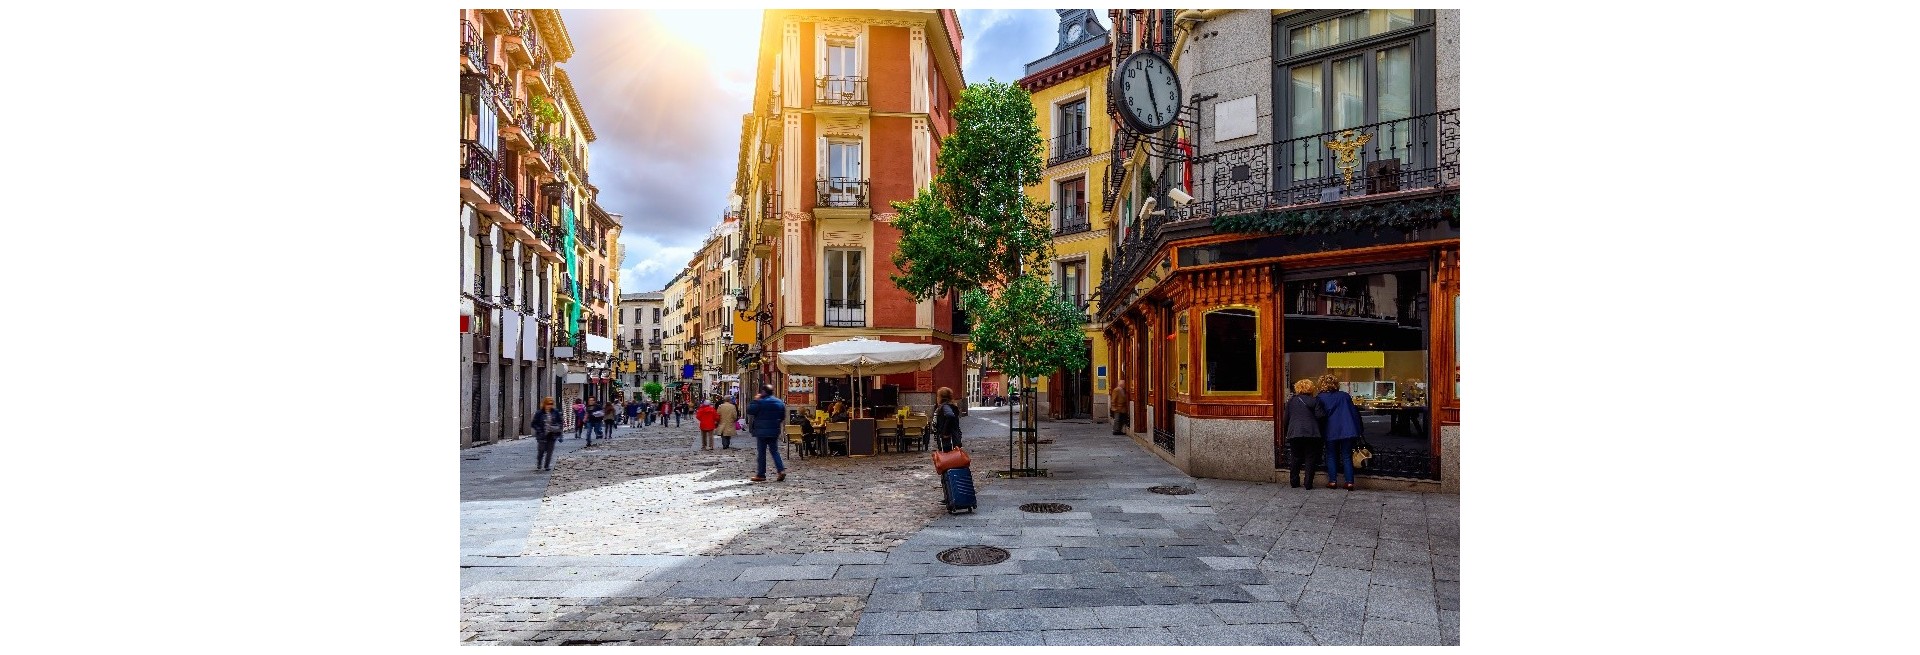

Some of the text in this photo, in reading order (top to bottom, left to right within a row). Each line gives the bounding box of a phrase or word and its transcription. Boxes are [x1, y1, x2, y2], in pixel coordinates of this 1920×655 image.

[1136, 61, 1142, 70] 11
[1146, 58, 1153, 68] 12
[1128, 69, 1135, 78] 10
[1158, 65, 1163, 74] 1
[1166, 77, 1171, 85] 2
[1125, 82, 1130, 91] 9
[1169, 91, 1174, 100] 3
[1128, 97, 1133, 106] 8
[1137, 108, 1142, 117] 7
[1166, 105, 1171, 113] 4
[1147, 114, 1152, 123] 6
[1159, 113, 1164, 121] 5
